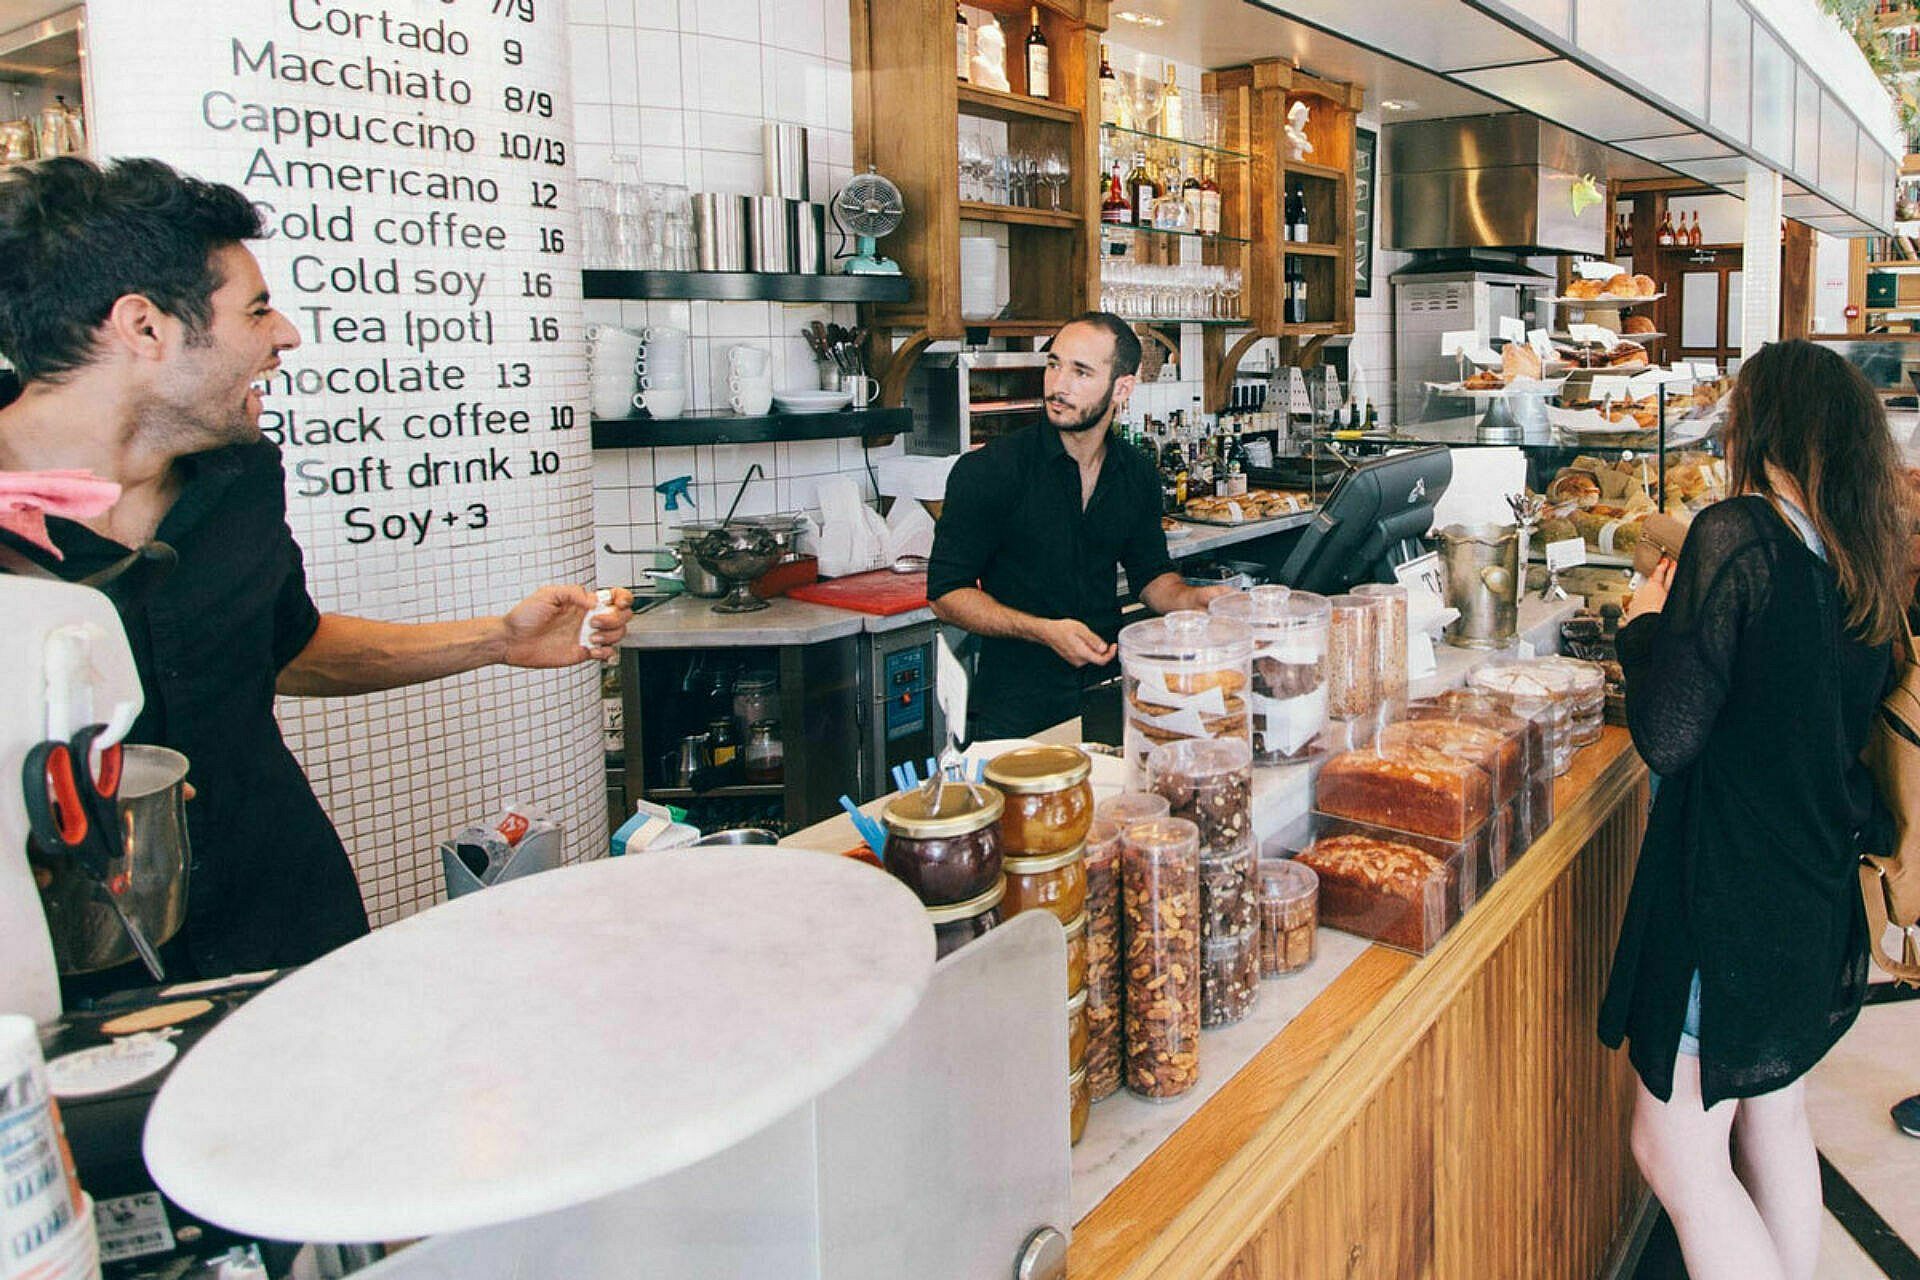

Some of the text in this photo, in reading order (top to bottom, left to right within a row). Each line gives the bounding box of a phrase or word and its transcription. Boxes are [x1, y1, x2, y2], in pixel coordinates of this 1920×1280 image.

[289, 0, 523, 65] Cortado 9
[231, 37, 553, 118] Macchiato 8/9
[202, 90, 566, 166] Cappuccino 10/13
[244, 147, 559, 210] Americano 12
[374, 211, 506, 250] coffee
[540, 227, 564, 254] 16
[292, 254, 553, 305] Cold soy 16
[299, 306, 386, 343] Tea
[529, 316, 560, 342] 16
[264, 358, 532, 396] hocolate 13
[403, 402, 530, 440] coffee
[550, 405, 575, 431] 10
[295, 447, 560, 497] Soft drink 10
